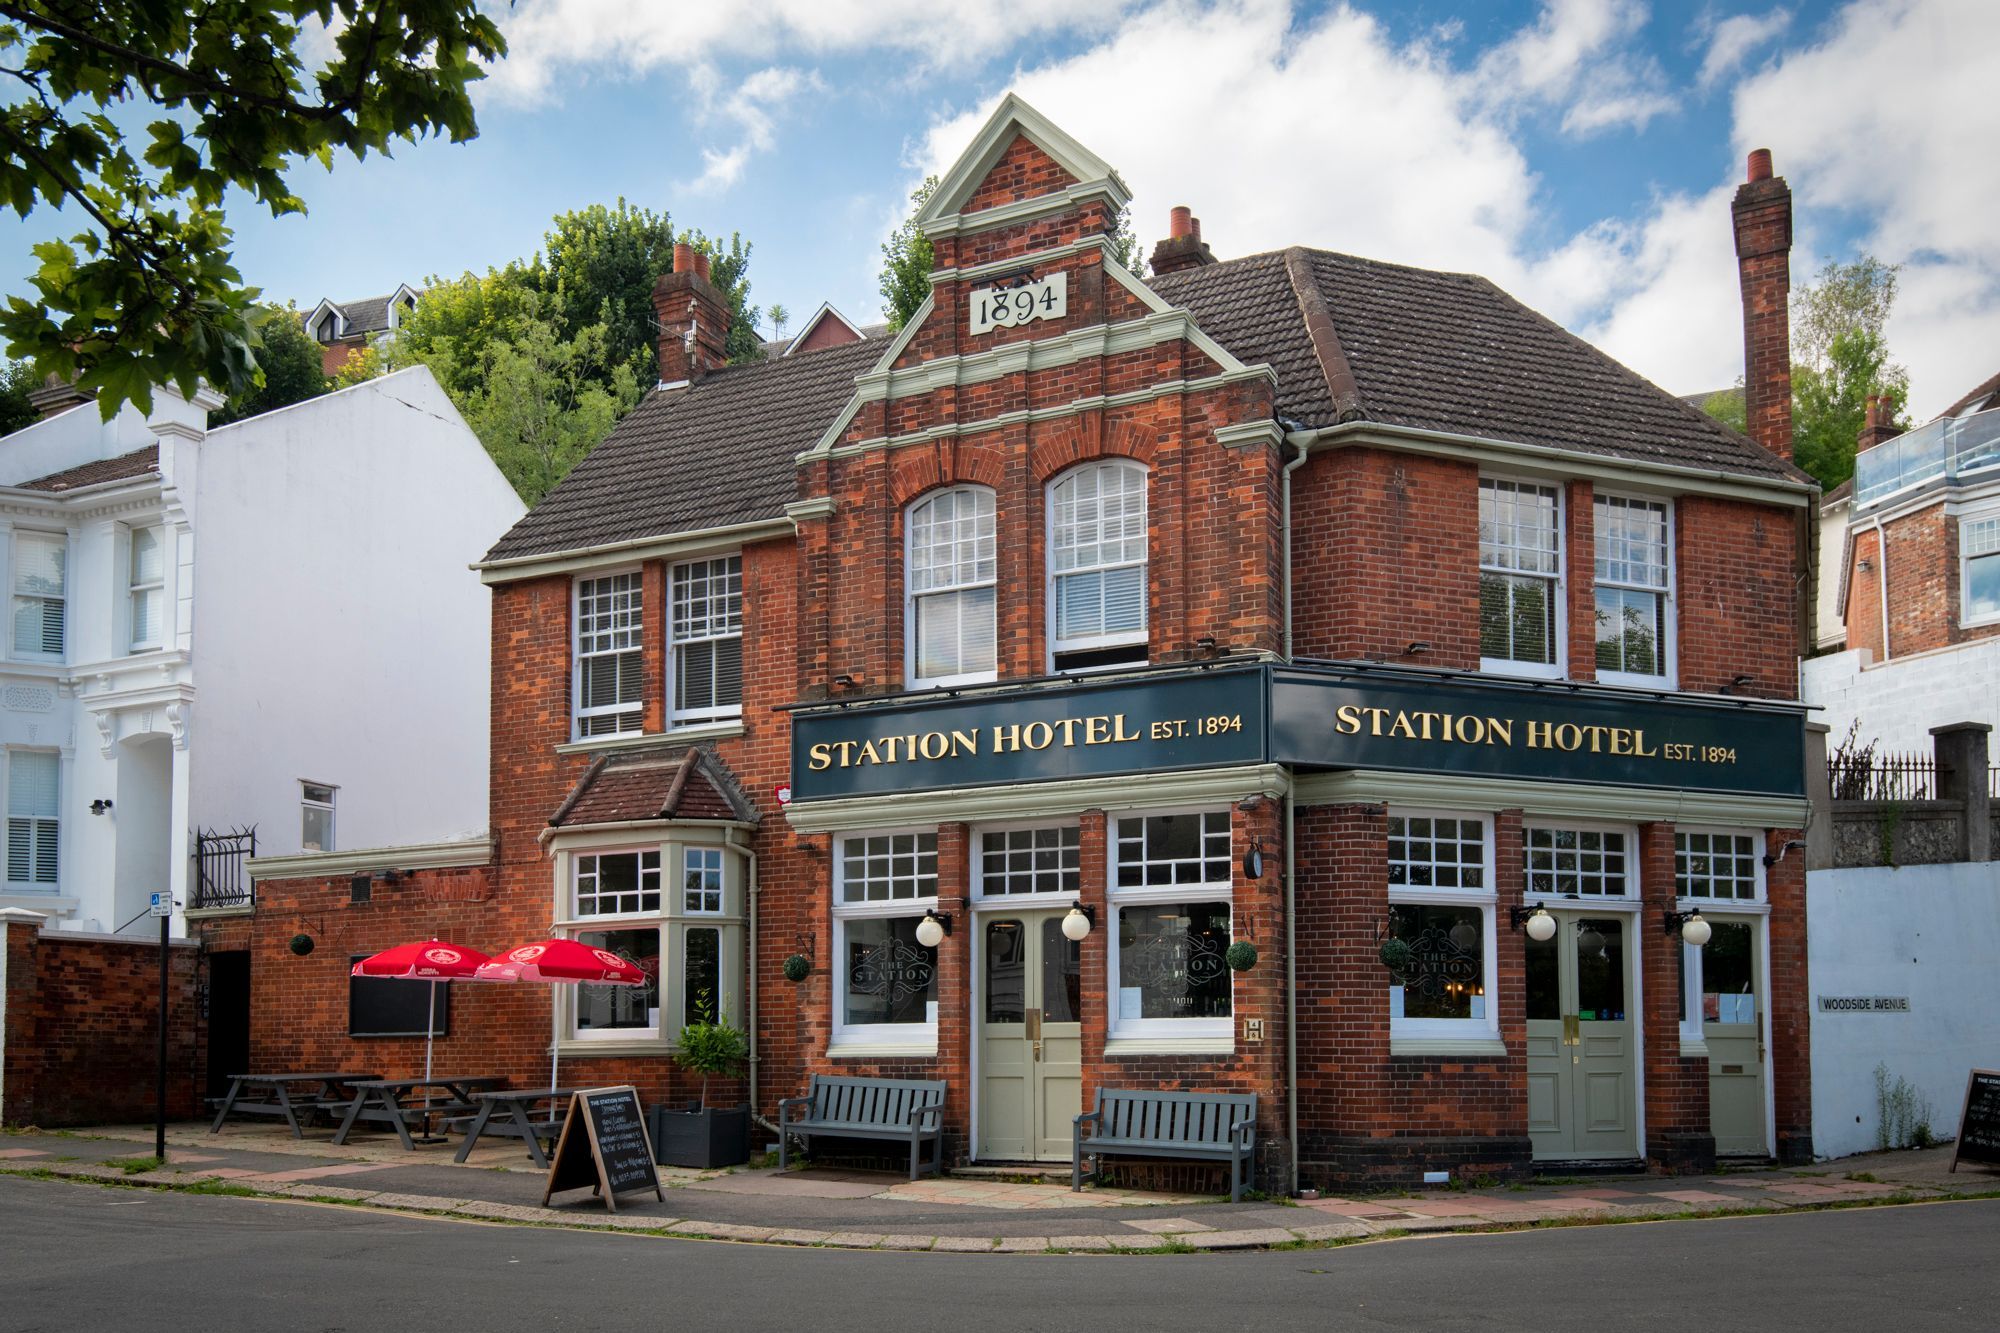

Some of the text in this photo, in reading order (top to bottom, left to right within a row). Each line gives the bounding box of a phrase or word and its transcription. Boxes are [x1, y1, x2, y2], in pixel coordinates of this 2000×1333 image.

[981, 286, 1057, 324] 1894
[1335, 705, 1736, 764] STATION HOTEL EST. 1894
[809, 714, 1242, 770] STATION HOTEL EST. 1894
[1422, 953, 1448, 961] THE
[880, 961, 904, 969] THE
[855, 970, 928, 981] STATION
[1824, 998, 1906, 1010] WOODSIDE AVENUE
